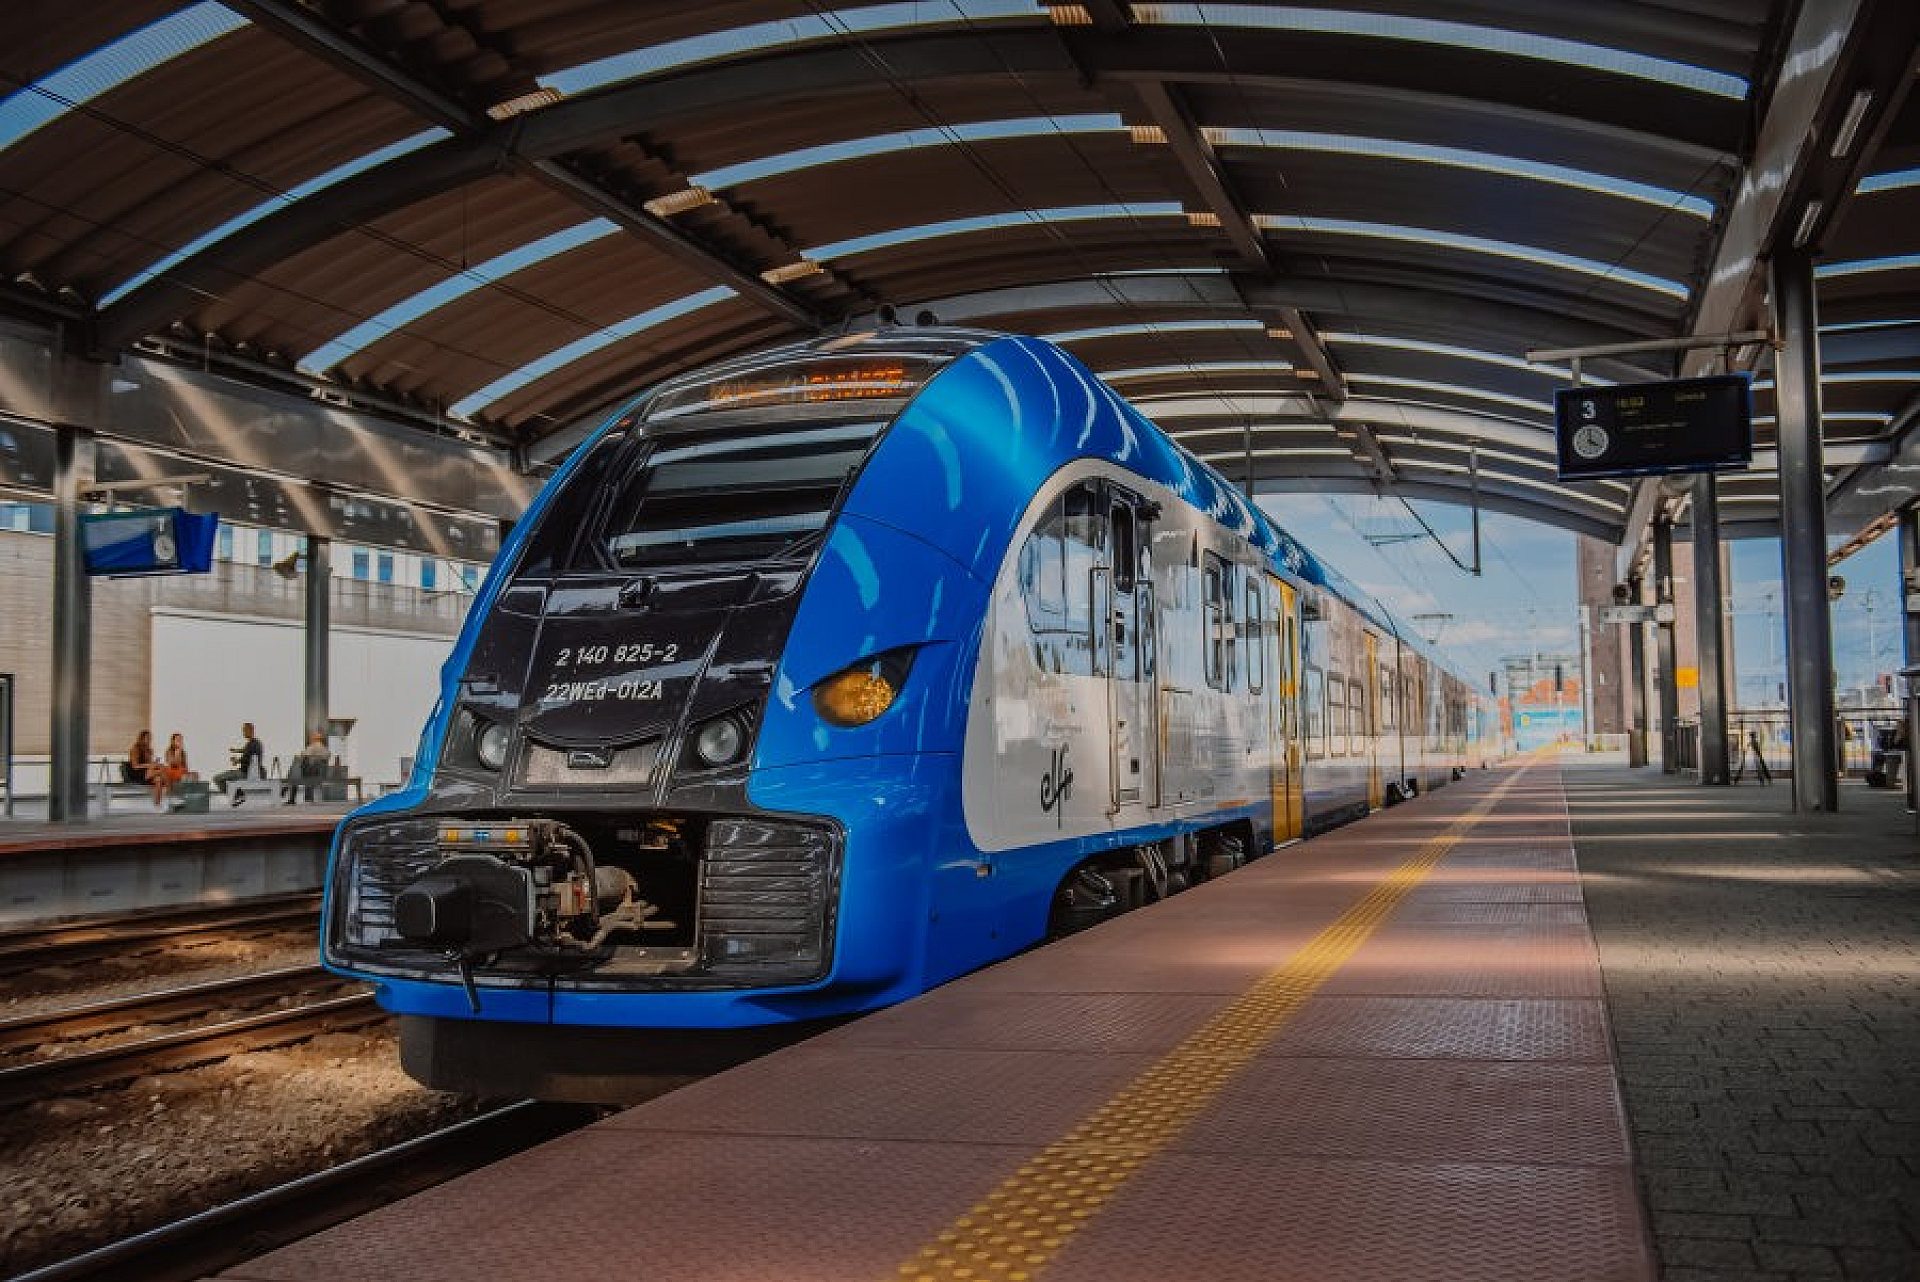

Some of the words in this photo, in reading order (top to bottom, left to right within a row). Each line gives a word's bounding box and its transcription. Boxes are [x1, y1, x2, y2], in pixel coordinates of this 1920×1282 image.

[1582, 400, 1597, 419] 3
[555, 647, 572, 667] 2
[576, 645, 609, 665] 140
[544, 679, 663, 703] 22WEd-012A
